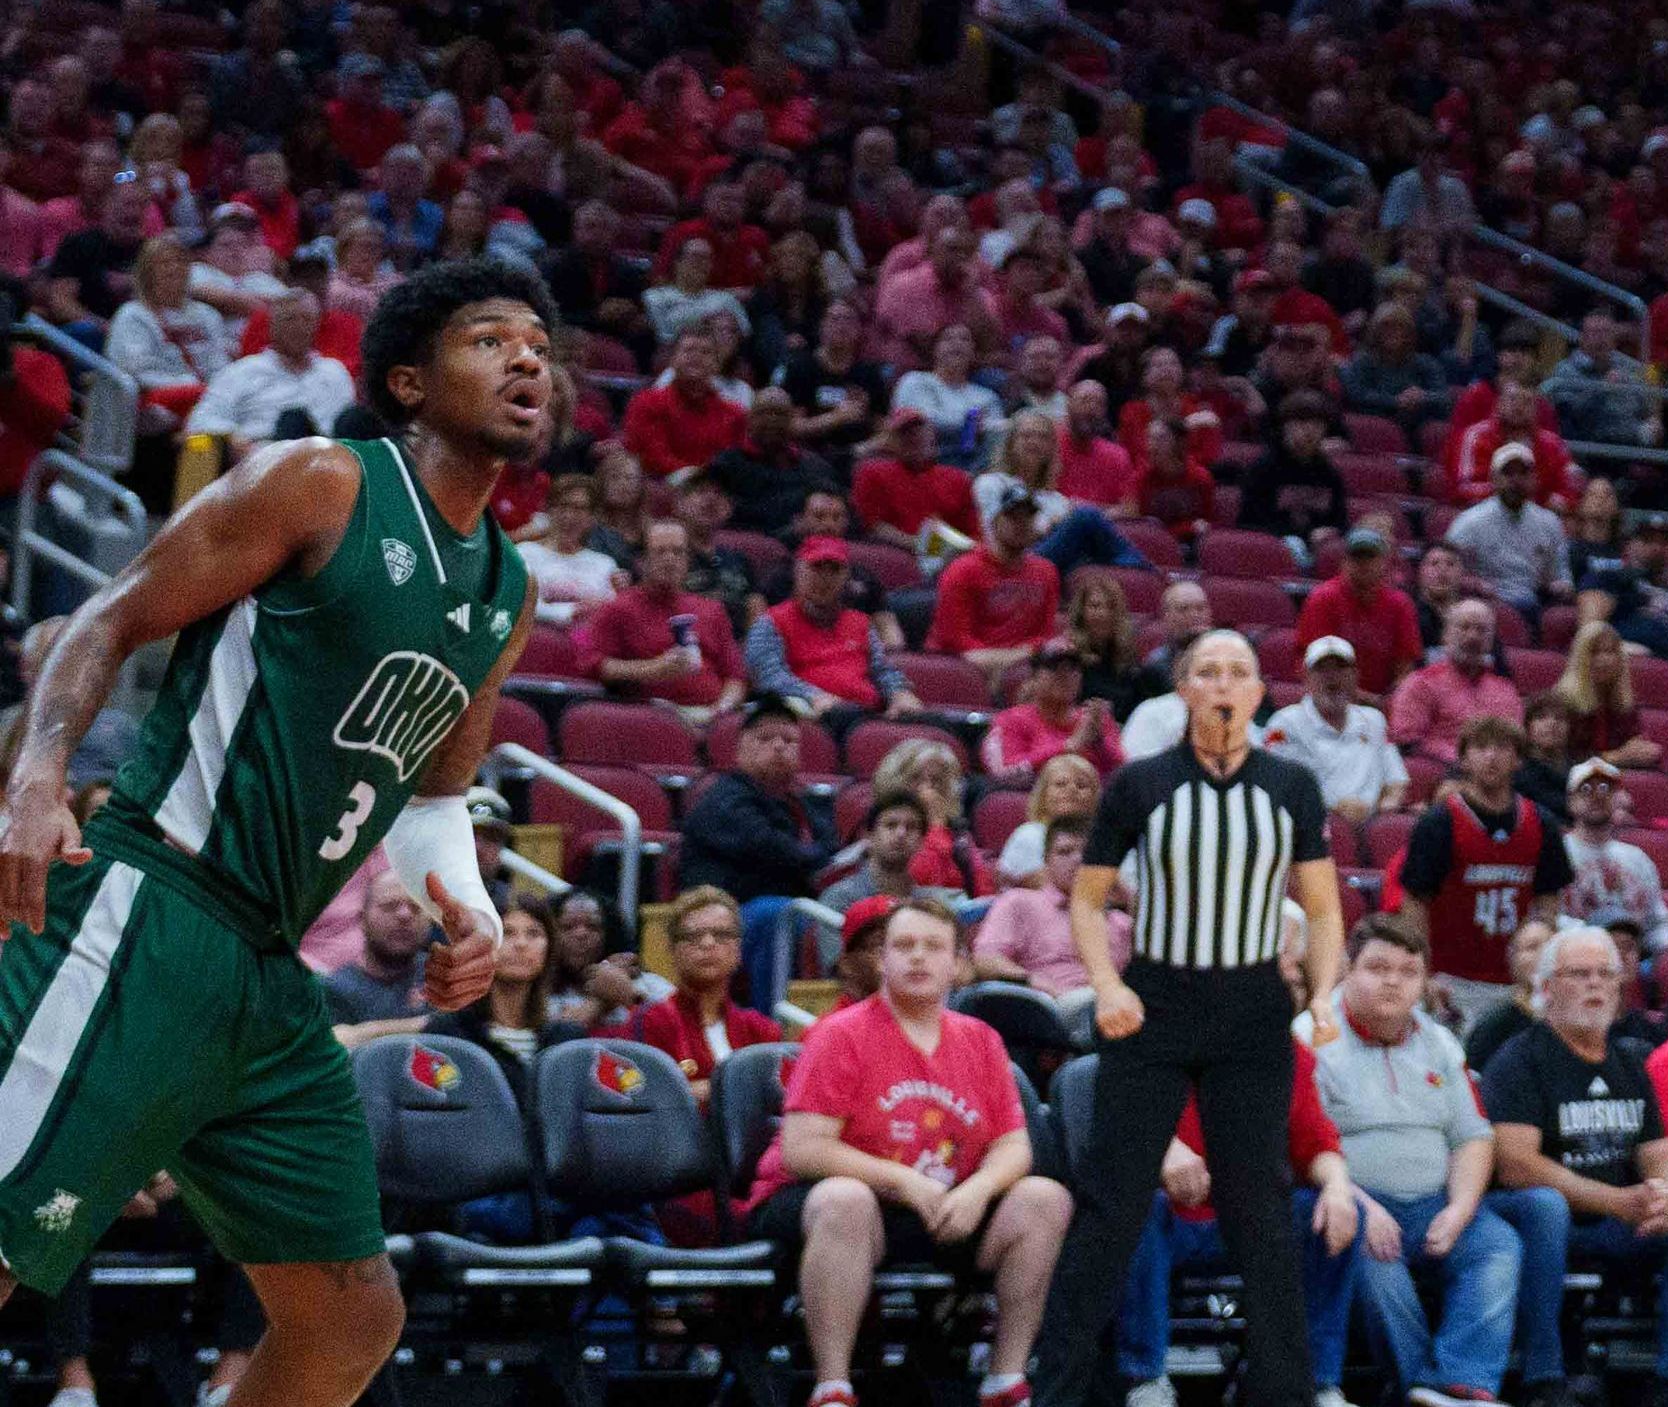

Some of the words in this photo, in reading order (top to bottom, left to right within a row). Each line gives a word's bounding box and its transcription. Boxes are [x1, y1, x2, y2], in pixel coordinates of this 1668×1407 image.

[333, 650, 470, 783] OHIO
[319, 780, 377, 861] 3
[1472, 888, 1519, 936] 45
